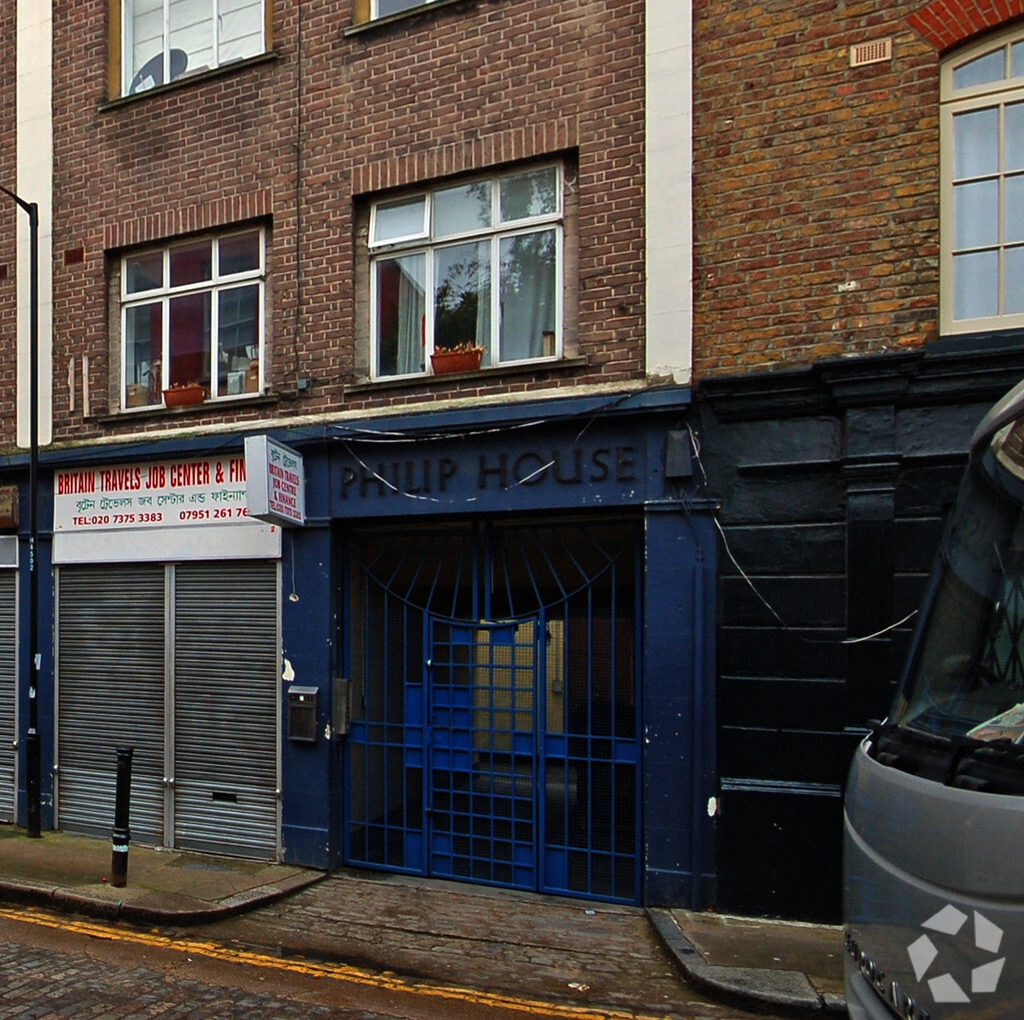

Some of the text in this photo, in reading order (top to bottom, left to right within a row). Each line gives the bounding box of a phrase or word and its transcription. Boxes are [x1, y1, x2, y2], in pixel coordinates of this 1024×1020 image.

[58, 471, 95, 495] BRITAIN
[100, 467, 141, 492] TRAVELS
[146, 465, 166, 489] JOB
[170, 461, 210, 487] CENTER
[215, 461, 225, 484] &
[340, 446, 637, 499] PHILIP HOUSE
[113, 514, 135, 524] 7375
[139, 513, 163, 522] 3383
[179, 510, 210, 521] 07951
[213, 508, 232, 519] 261
